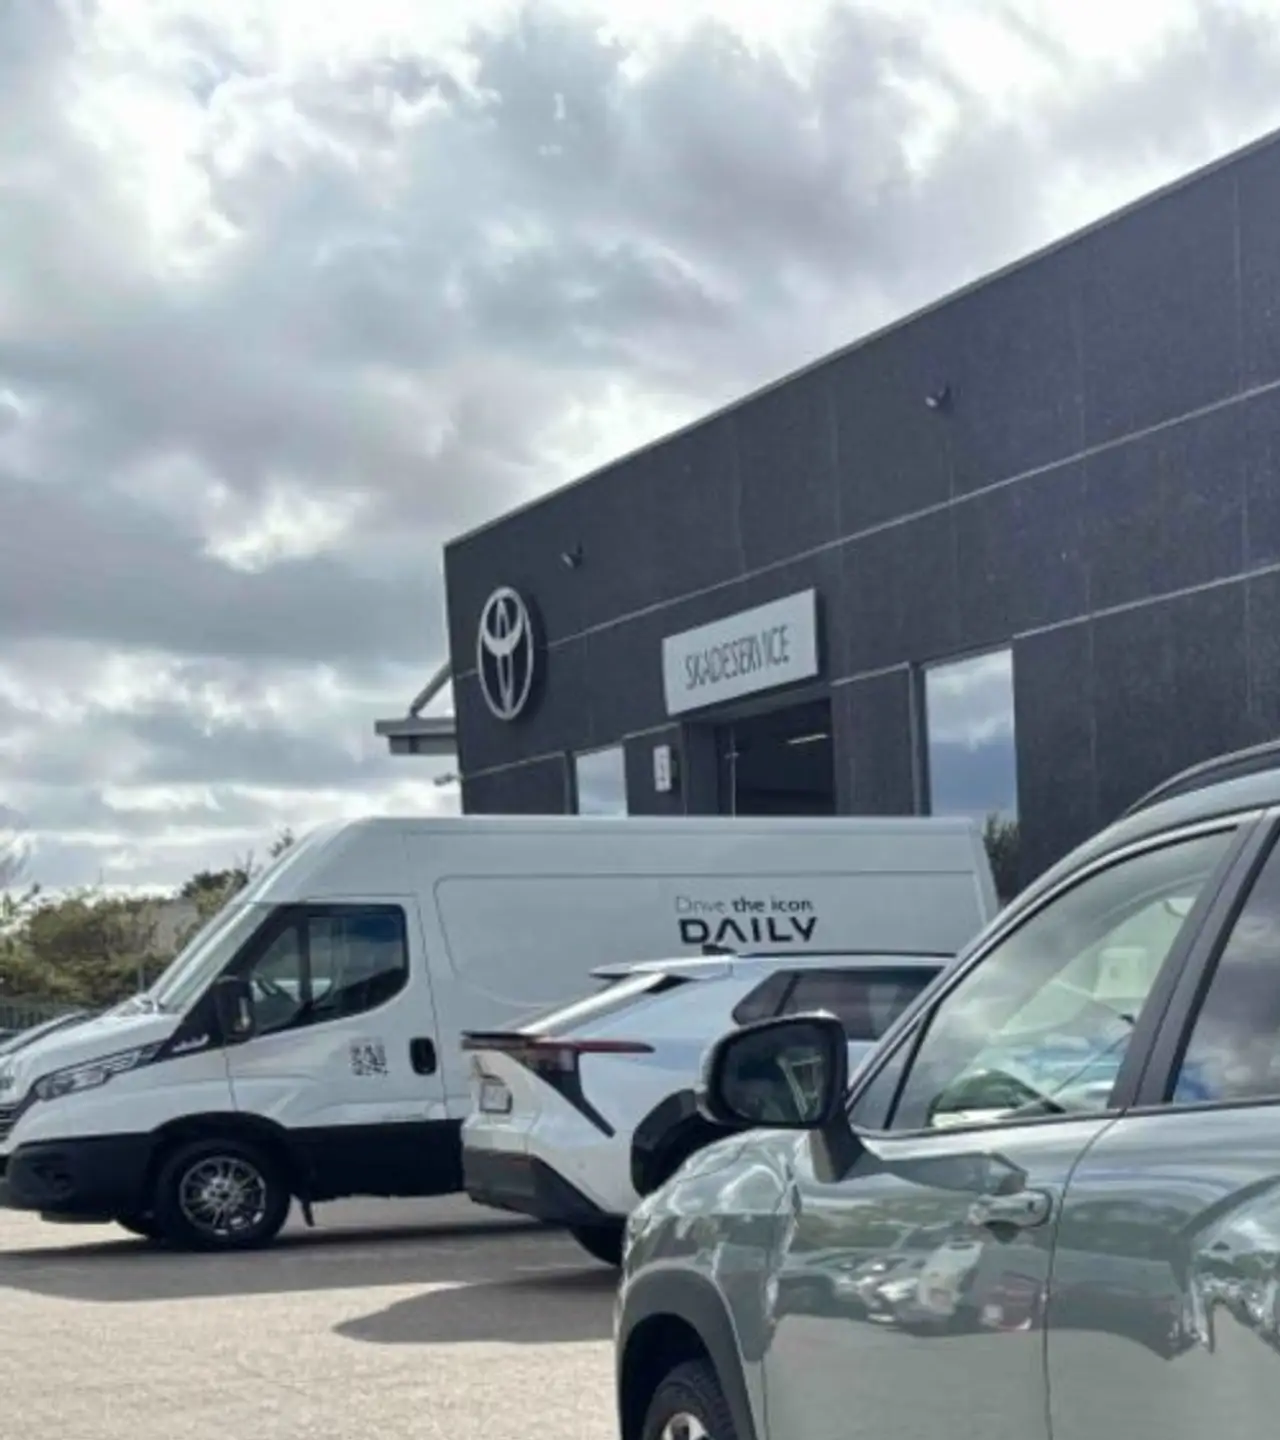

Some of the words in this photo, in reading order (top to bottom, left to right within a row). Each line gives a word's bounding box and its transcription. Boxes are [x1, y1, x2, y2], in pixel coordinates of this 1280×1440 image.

[685, 625, 790, 690] SKADESERVICE
[676, 896, 725, 914] Drive
[732, 896, 765, 913] the
[771, 895, 814, 913] icon
[678, 916, 817, 944] DAILY
